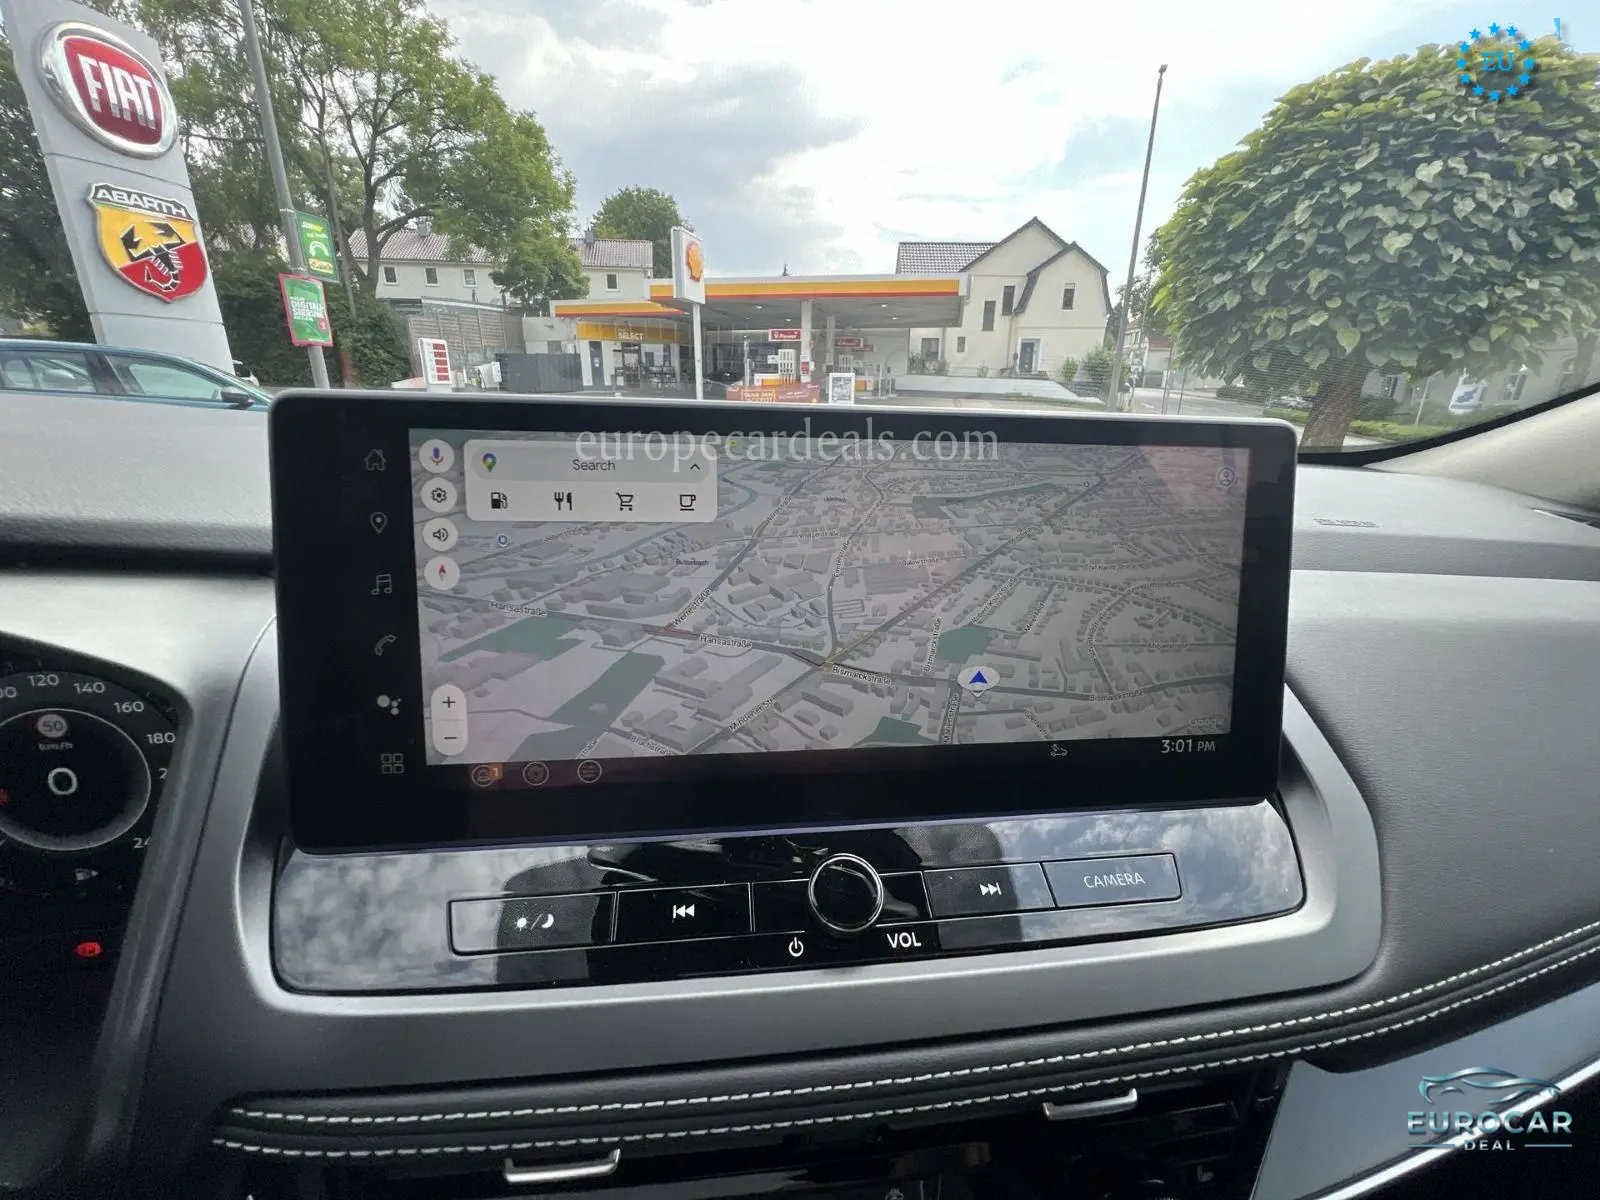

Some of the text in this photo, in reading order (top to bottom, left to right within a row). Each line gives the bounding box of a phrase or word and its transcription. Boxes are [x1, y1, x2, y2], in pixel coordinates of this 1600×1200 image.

[77, 54, 156, 130] FIAT
[97, 188, 188, 219] ABARTH
[617, 331, 644, 340] SELECT
[572, 457, 617, 472] Search
[490, 601, 548, 617] Hansastraße
[672, 587, 713, 627] Werrestraße
[699, 634, 753, 650] Hansastraße
[27, 674, 60, 687] 120
[832, 666, 892, 685] Bismarckstraße
[74, 681, 106, 694] 140
[113, 700, 145, 713] 160
[728, 705, 764, 733] Mindener
[146, 732, 176, 744] 180
[1161, 739, 1216, 754] 3:01 PM
[1083, 872, 1146, 889] CAMERA
[886, 932, 922, 950] VOL
